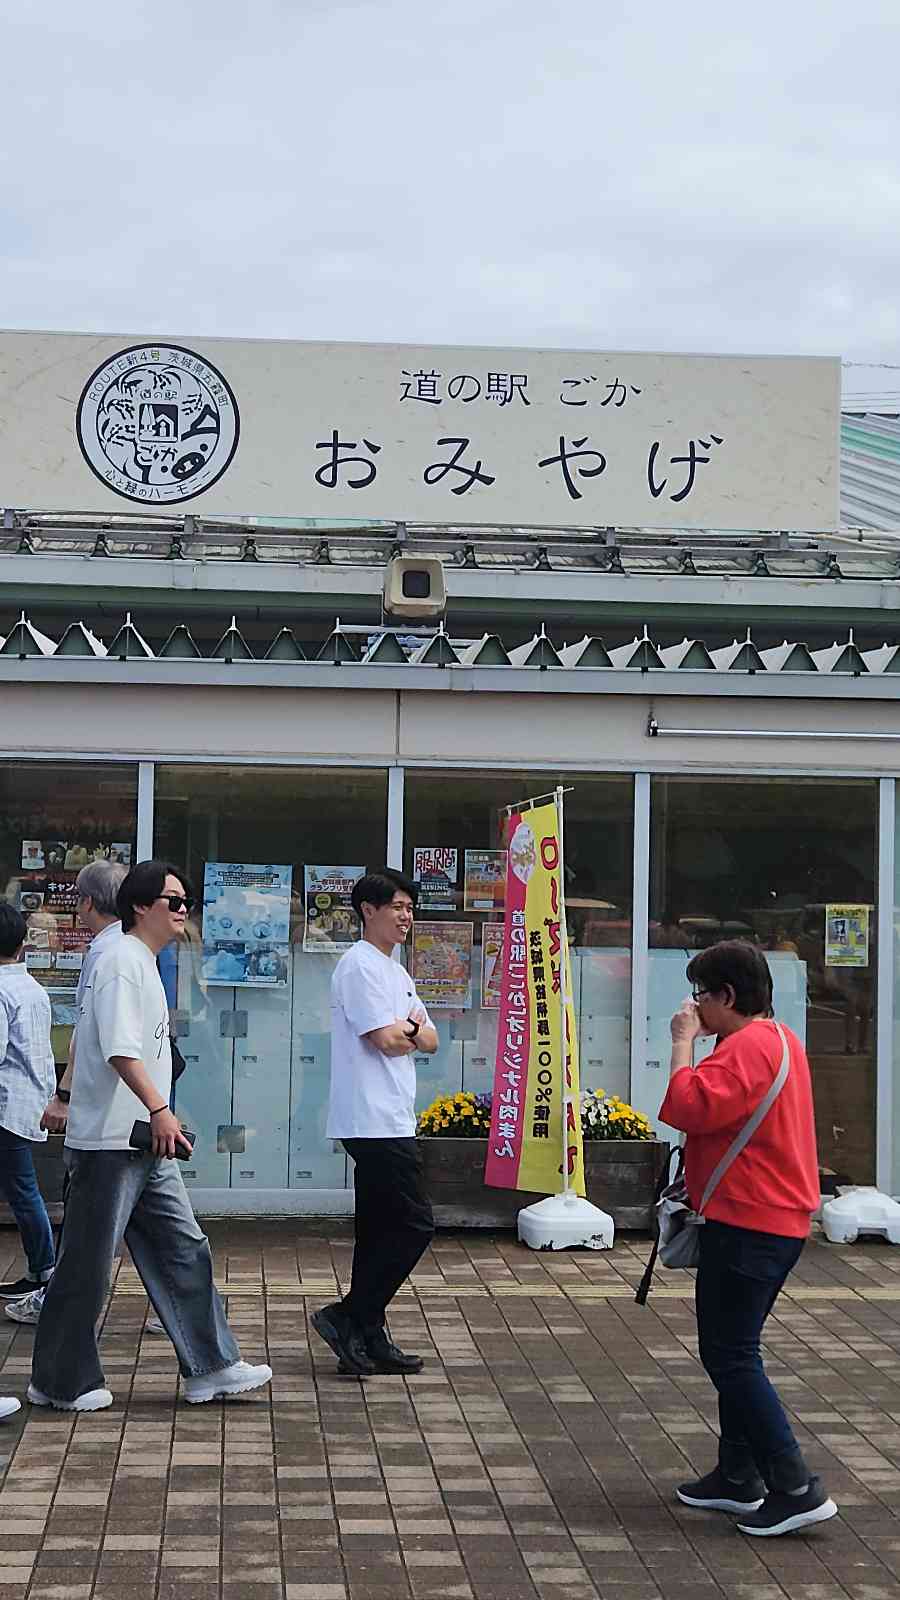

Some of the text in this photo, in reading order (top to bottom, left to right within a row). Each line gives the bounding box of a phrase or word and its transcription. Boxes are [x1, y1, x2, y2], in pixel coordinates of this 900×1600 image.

[400, 370, 642, 408] 道の駅 ごか
[104, 469, 212, 499] 心と緑のハーモニー
[314, 430, 724, 503] おみやげ
